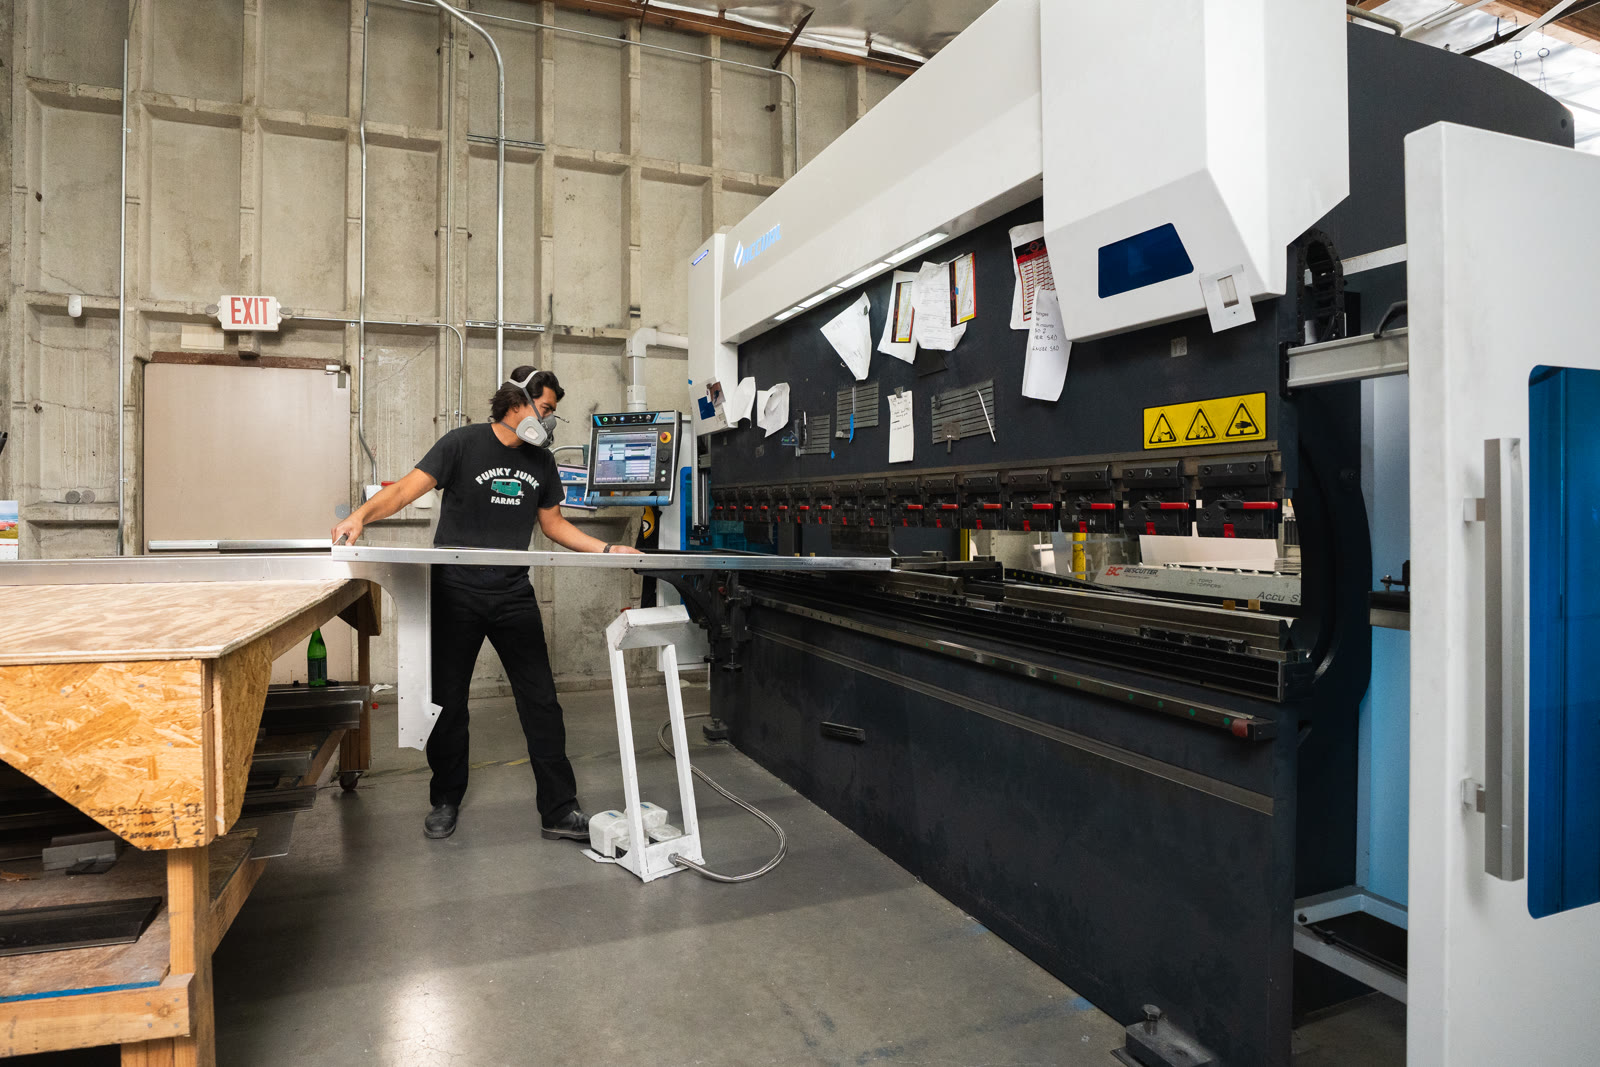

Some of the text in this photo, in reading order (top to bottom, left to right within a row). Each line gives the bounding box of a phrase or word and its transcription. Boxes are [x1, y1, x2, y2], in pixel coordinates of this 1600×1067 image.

[231, 297, 269, 324] EXIT
[475, 467, 511, 485] FUNKY
[513, 469, 540, 490] JUNK
[490, 496, 521, 506] FARMS
[1105, 565, 1124, 577] BC
